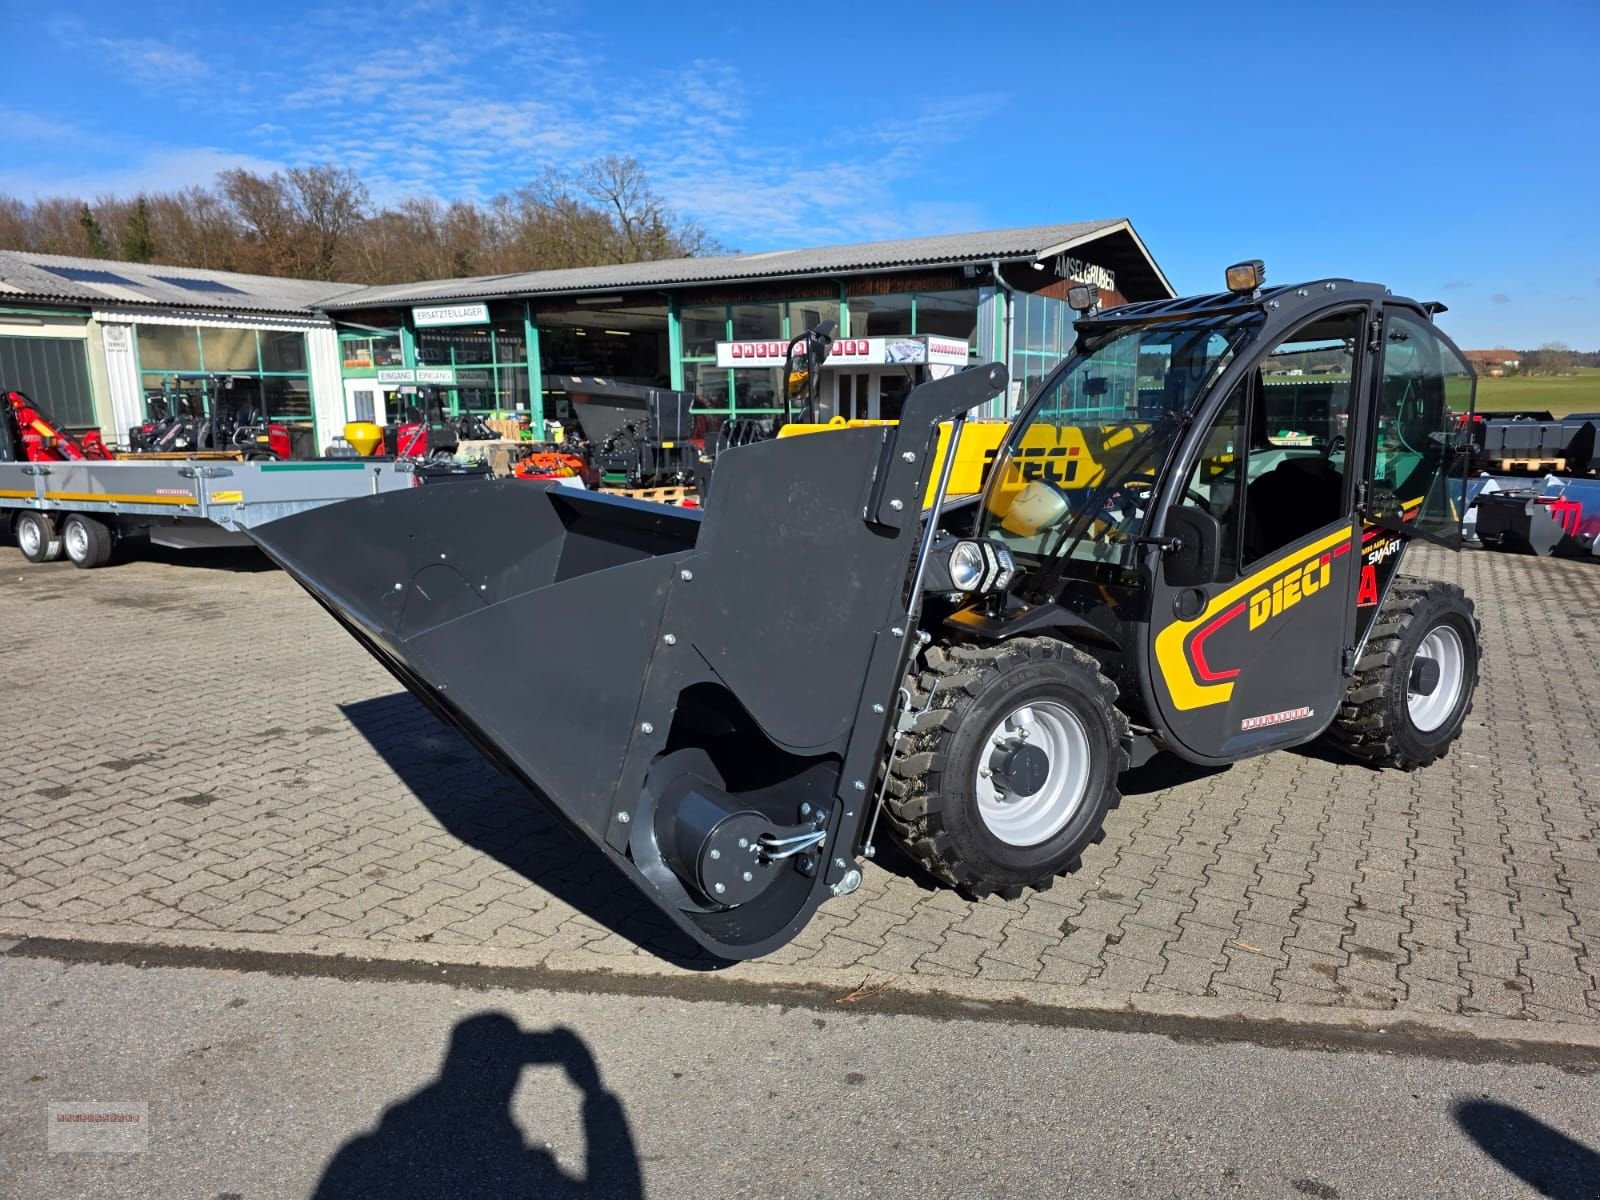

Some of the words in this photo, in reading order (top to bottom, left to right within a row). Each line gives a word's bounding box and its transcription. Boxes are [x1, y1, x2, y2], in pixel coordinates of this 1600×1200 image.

[1054, 255, 1115, 292] AMSELGRUBER
[417, 307, 483, 320] ERSATZTEILLAGER
[731, 338, 869, 358] AMSELGBER
[380, 371, 413, 380] EINGANG
[418, 371, 451, 380] EINGANG
[1368, 538, 1402, 566] SMART
[1249, 553, 1331, 632] DIECI
